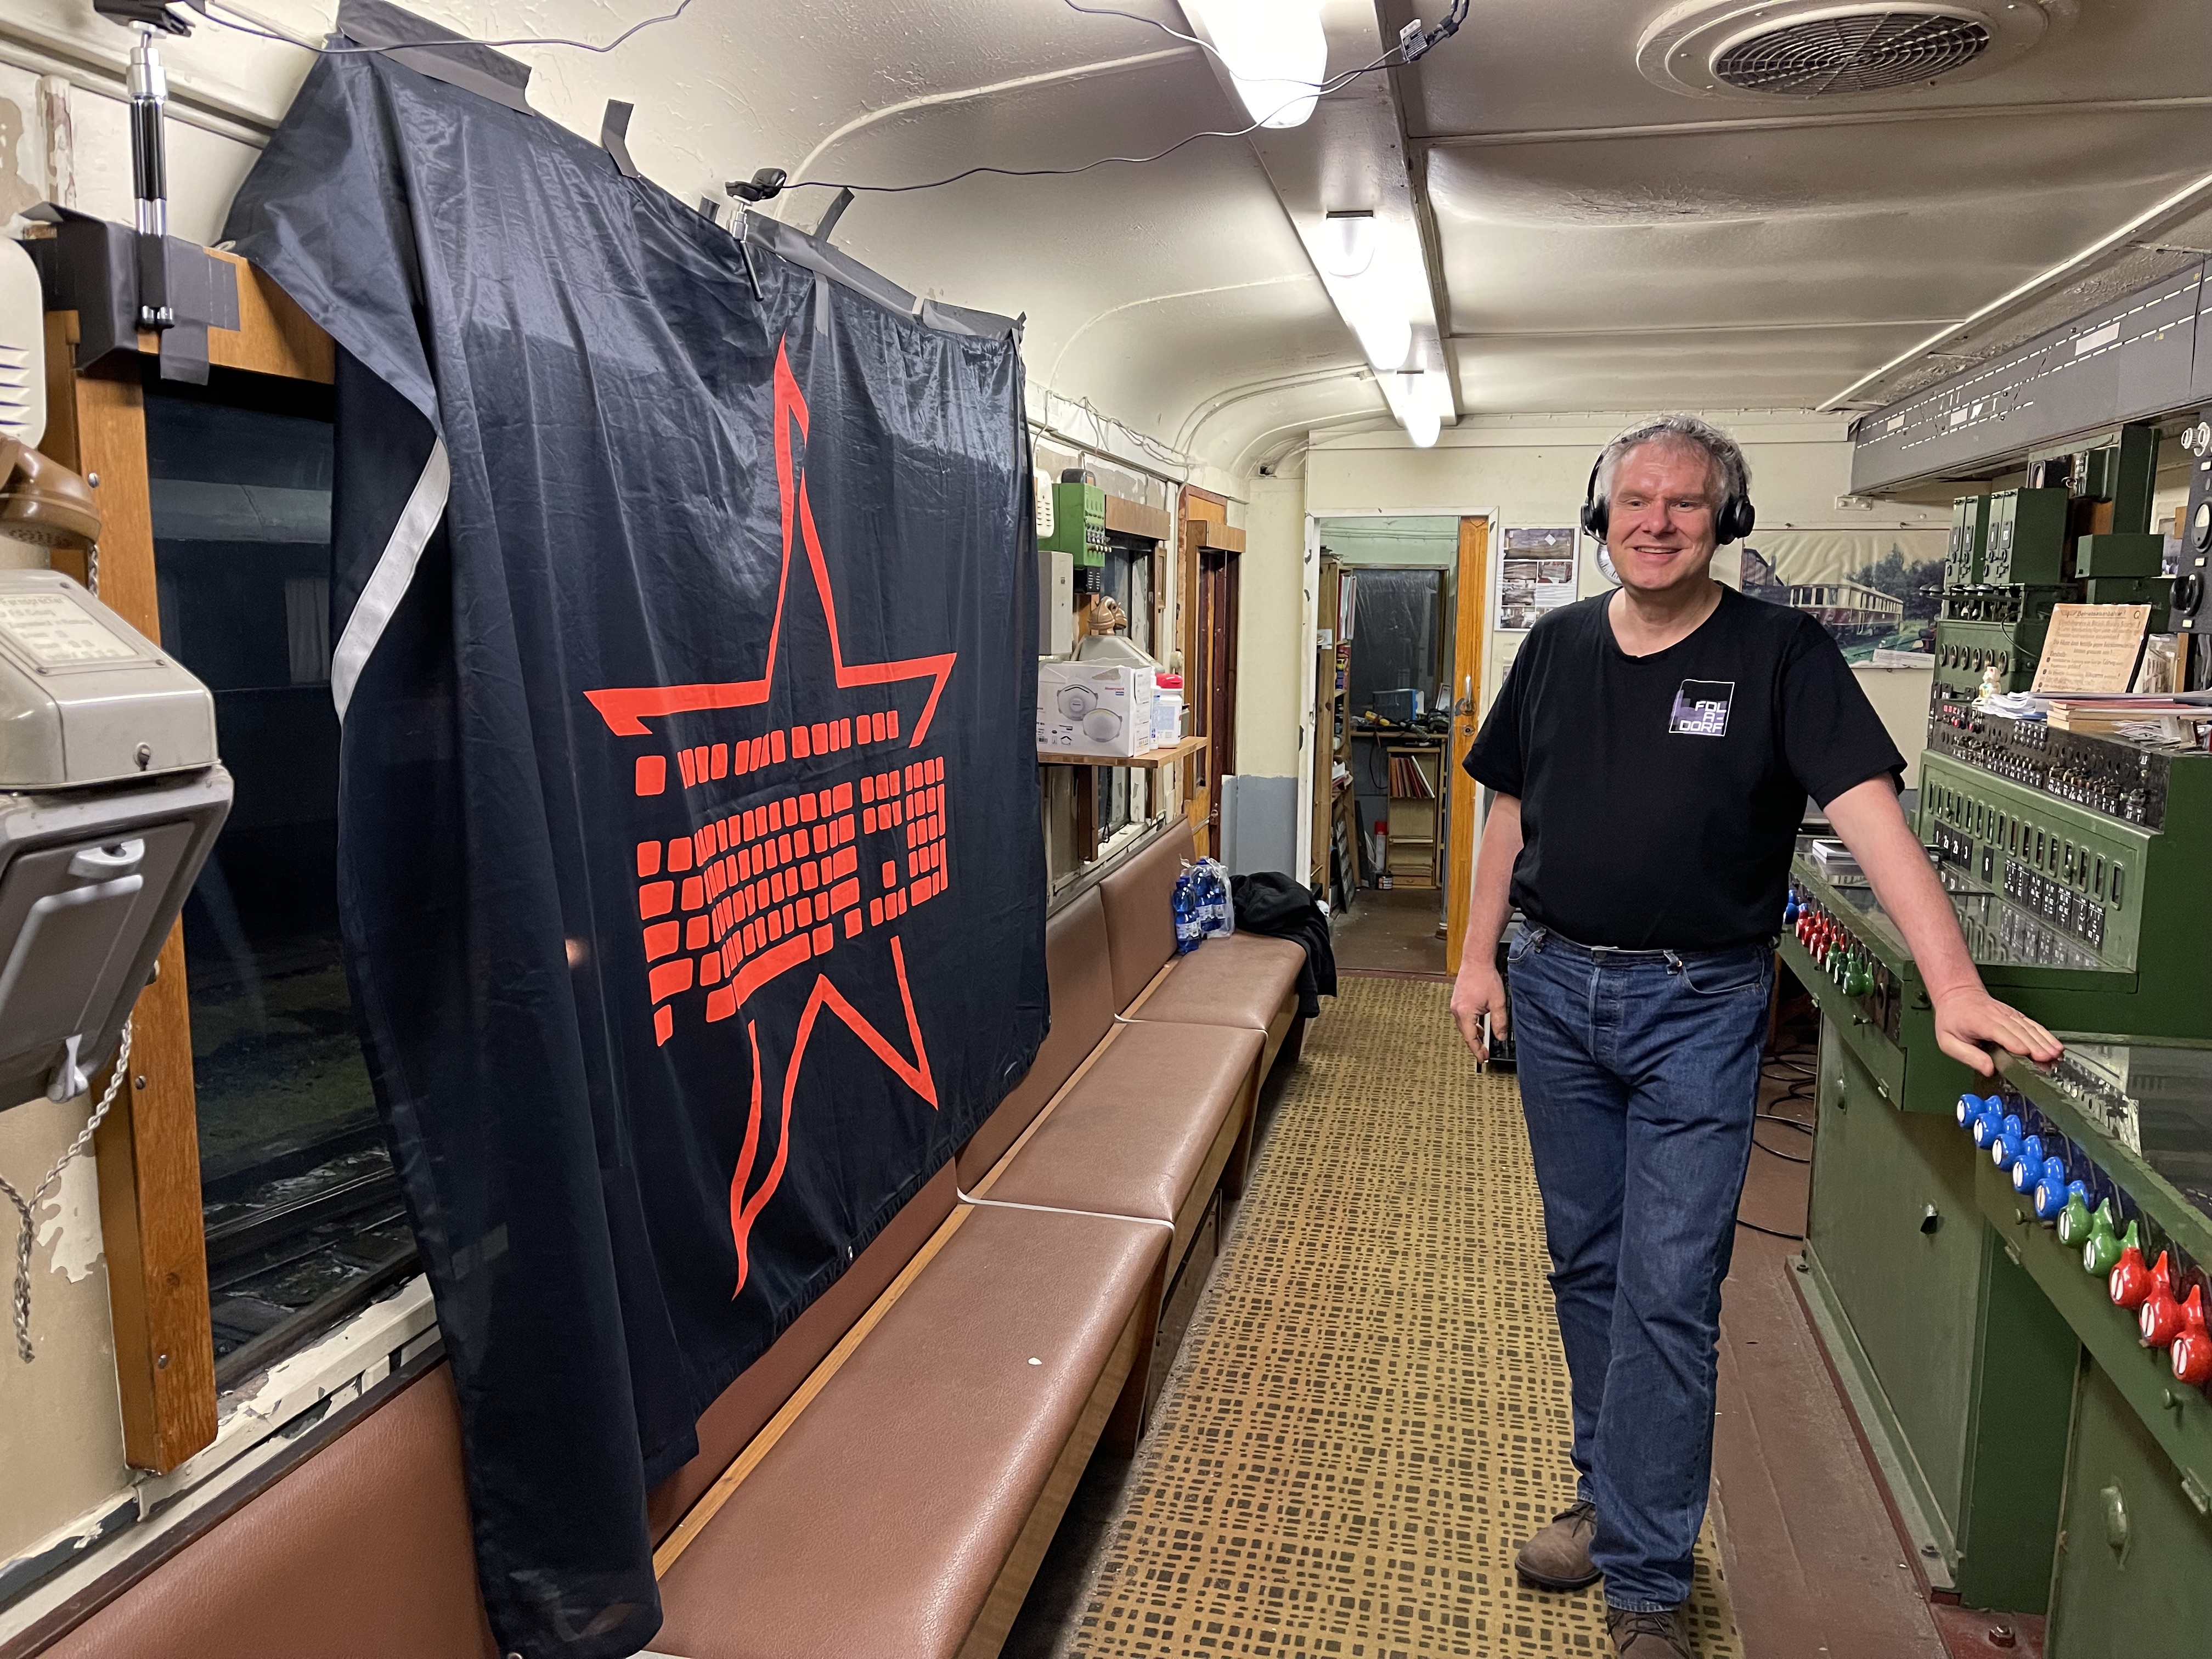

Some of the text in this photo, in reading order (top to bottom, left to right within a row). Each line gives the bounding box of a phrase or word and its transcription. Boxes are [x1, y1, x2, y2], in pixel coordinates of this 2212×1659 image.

[1695, 701, 1726, 713] FDL
[1703, 712, 1724, 722] A-
[1679, 720, 1724, 733] DORF
